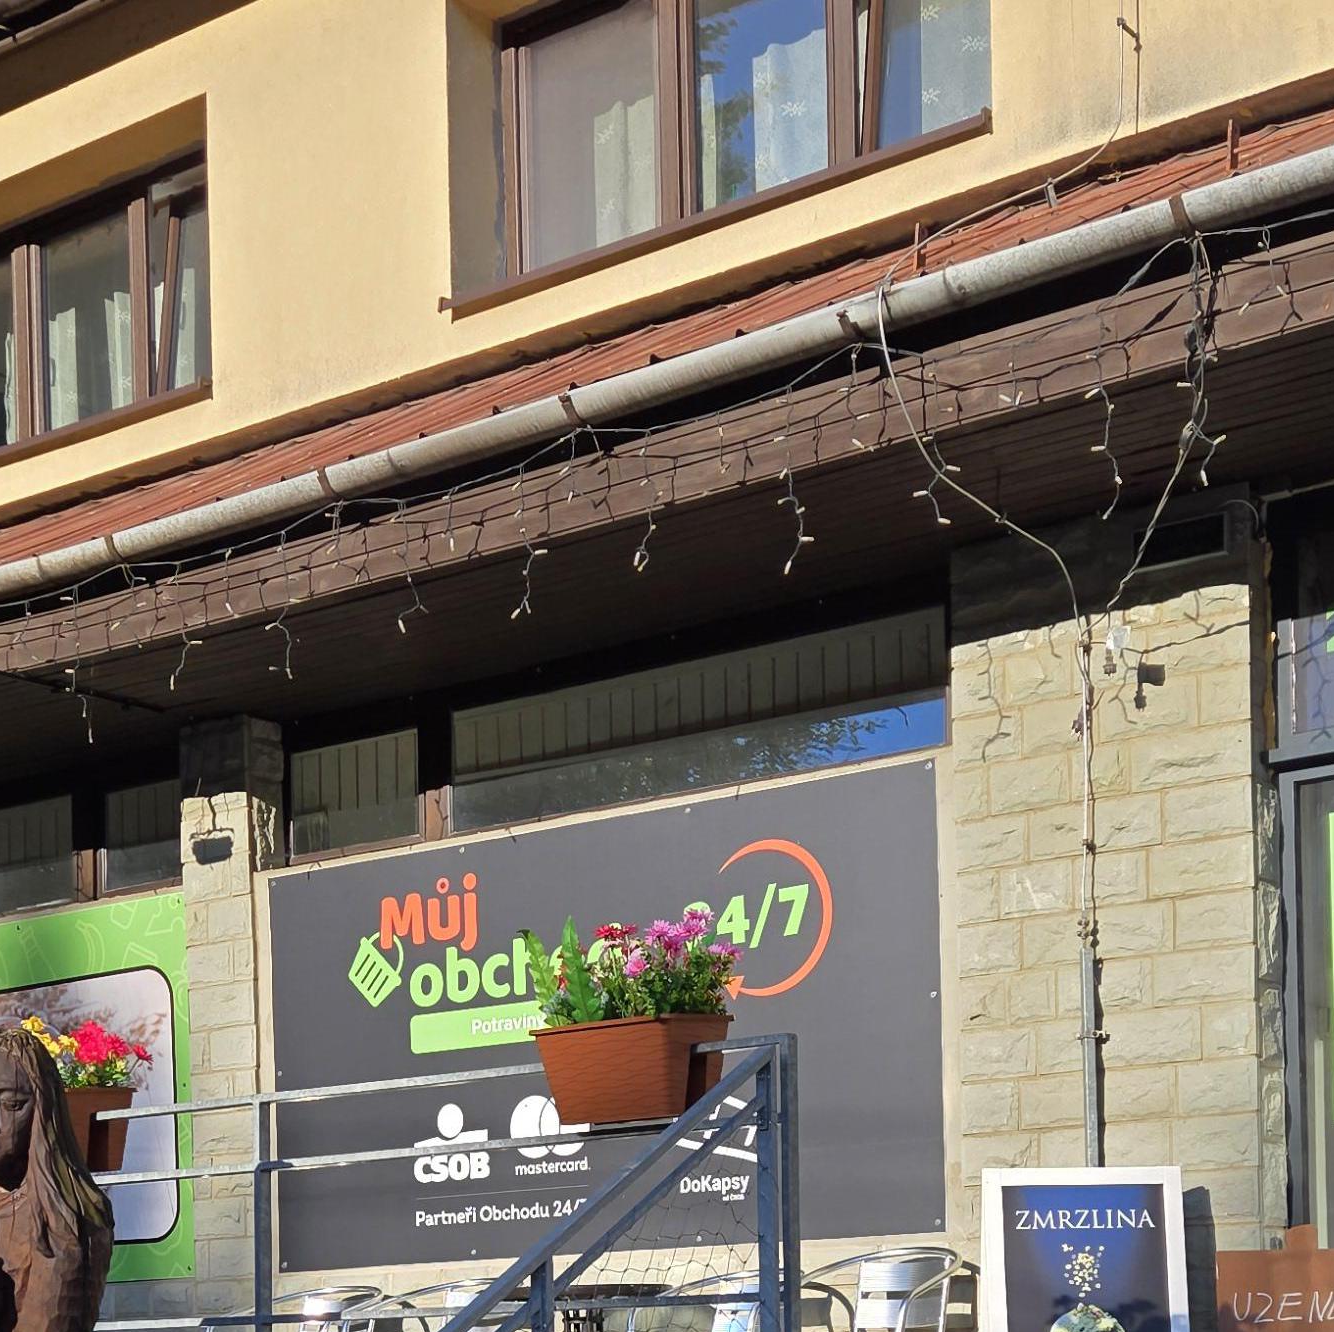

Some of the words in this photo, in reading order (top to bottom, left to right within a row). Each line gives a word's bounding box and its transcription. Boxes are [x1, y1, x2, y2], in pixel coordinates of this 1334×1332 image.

[380, 872, 478, 951] Můj
[471, 1012, 547, 1036] Potraviny
[680, 1174, 750, 1195] DoKapsy
[415, 1206, 477, 1227] Partneři
[479, 1200, 550, 1222] Obchodu
[1015, 1208, 1156, 1231] ZMRZLINA
